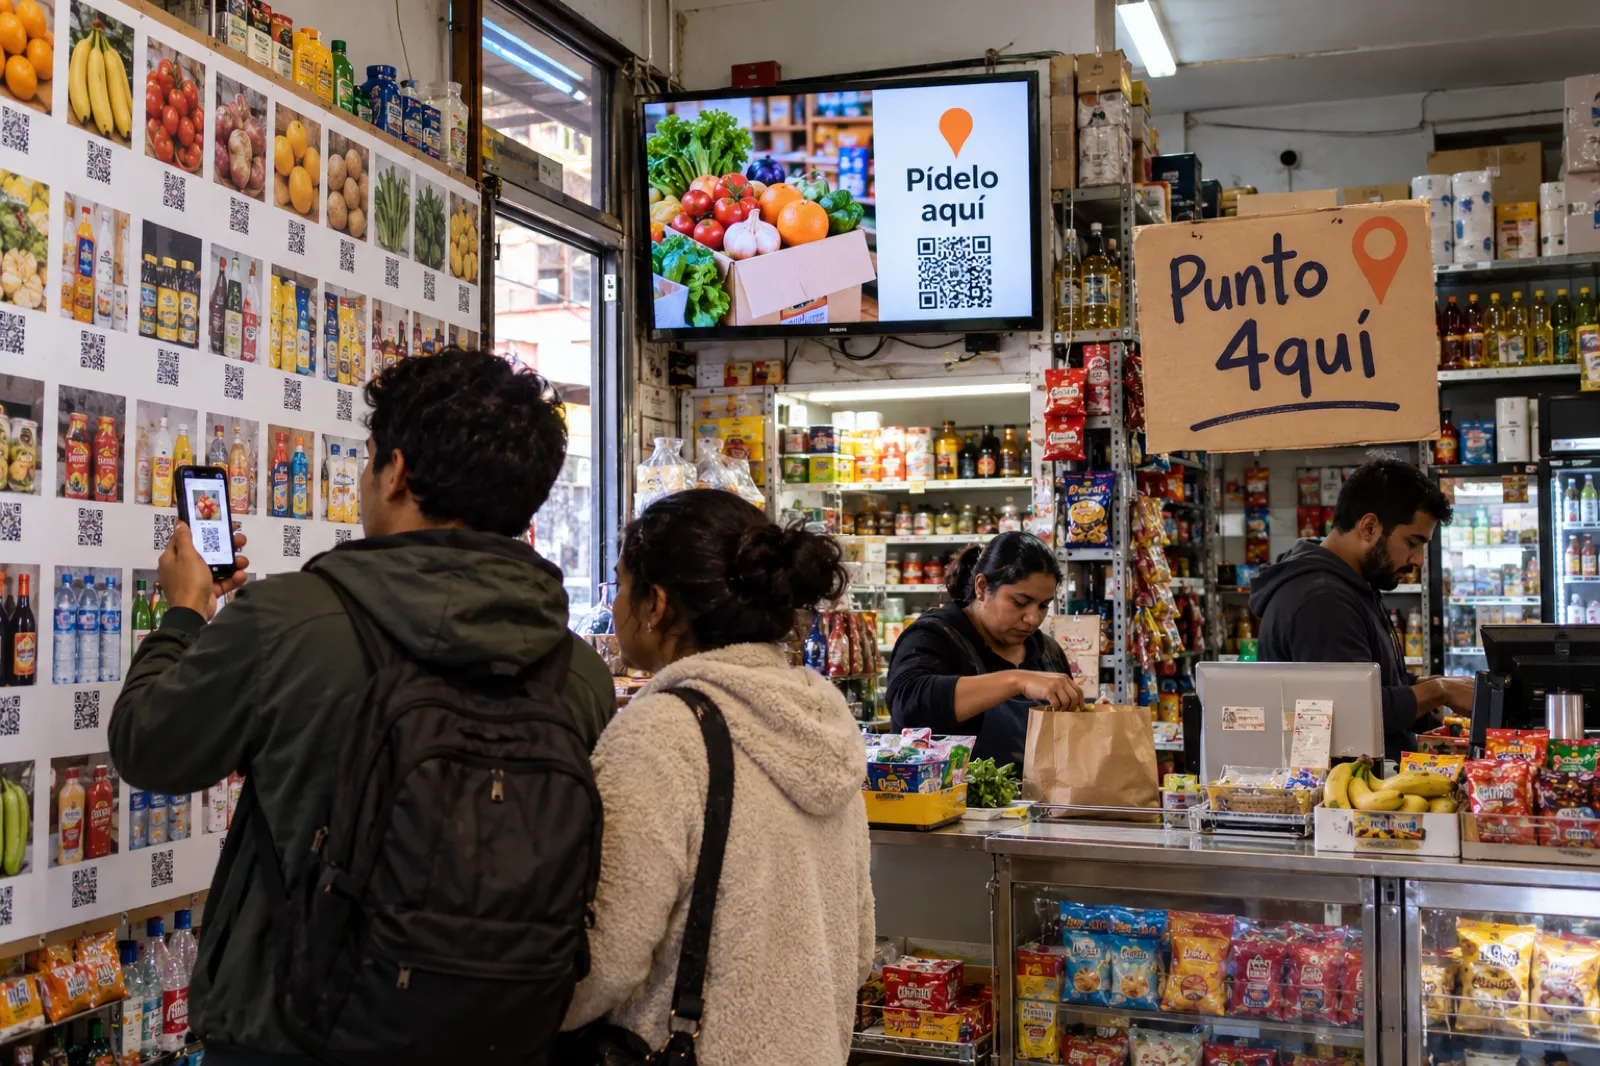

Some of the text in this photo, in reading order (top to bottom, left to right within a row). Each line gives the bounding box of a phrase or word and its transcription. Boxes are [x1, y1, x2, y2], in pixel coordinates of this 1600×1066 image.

[906, 164, 999, 192] Pídelo
[921, 194, 986, 228] aquí
[1169, 232, 1329, 325] Punto
